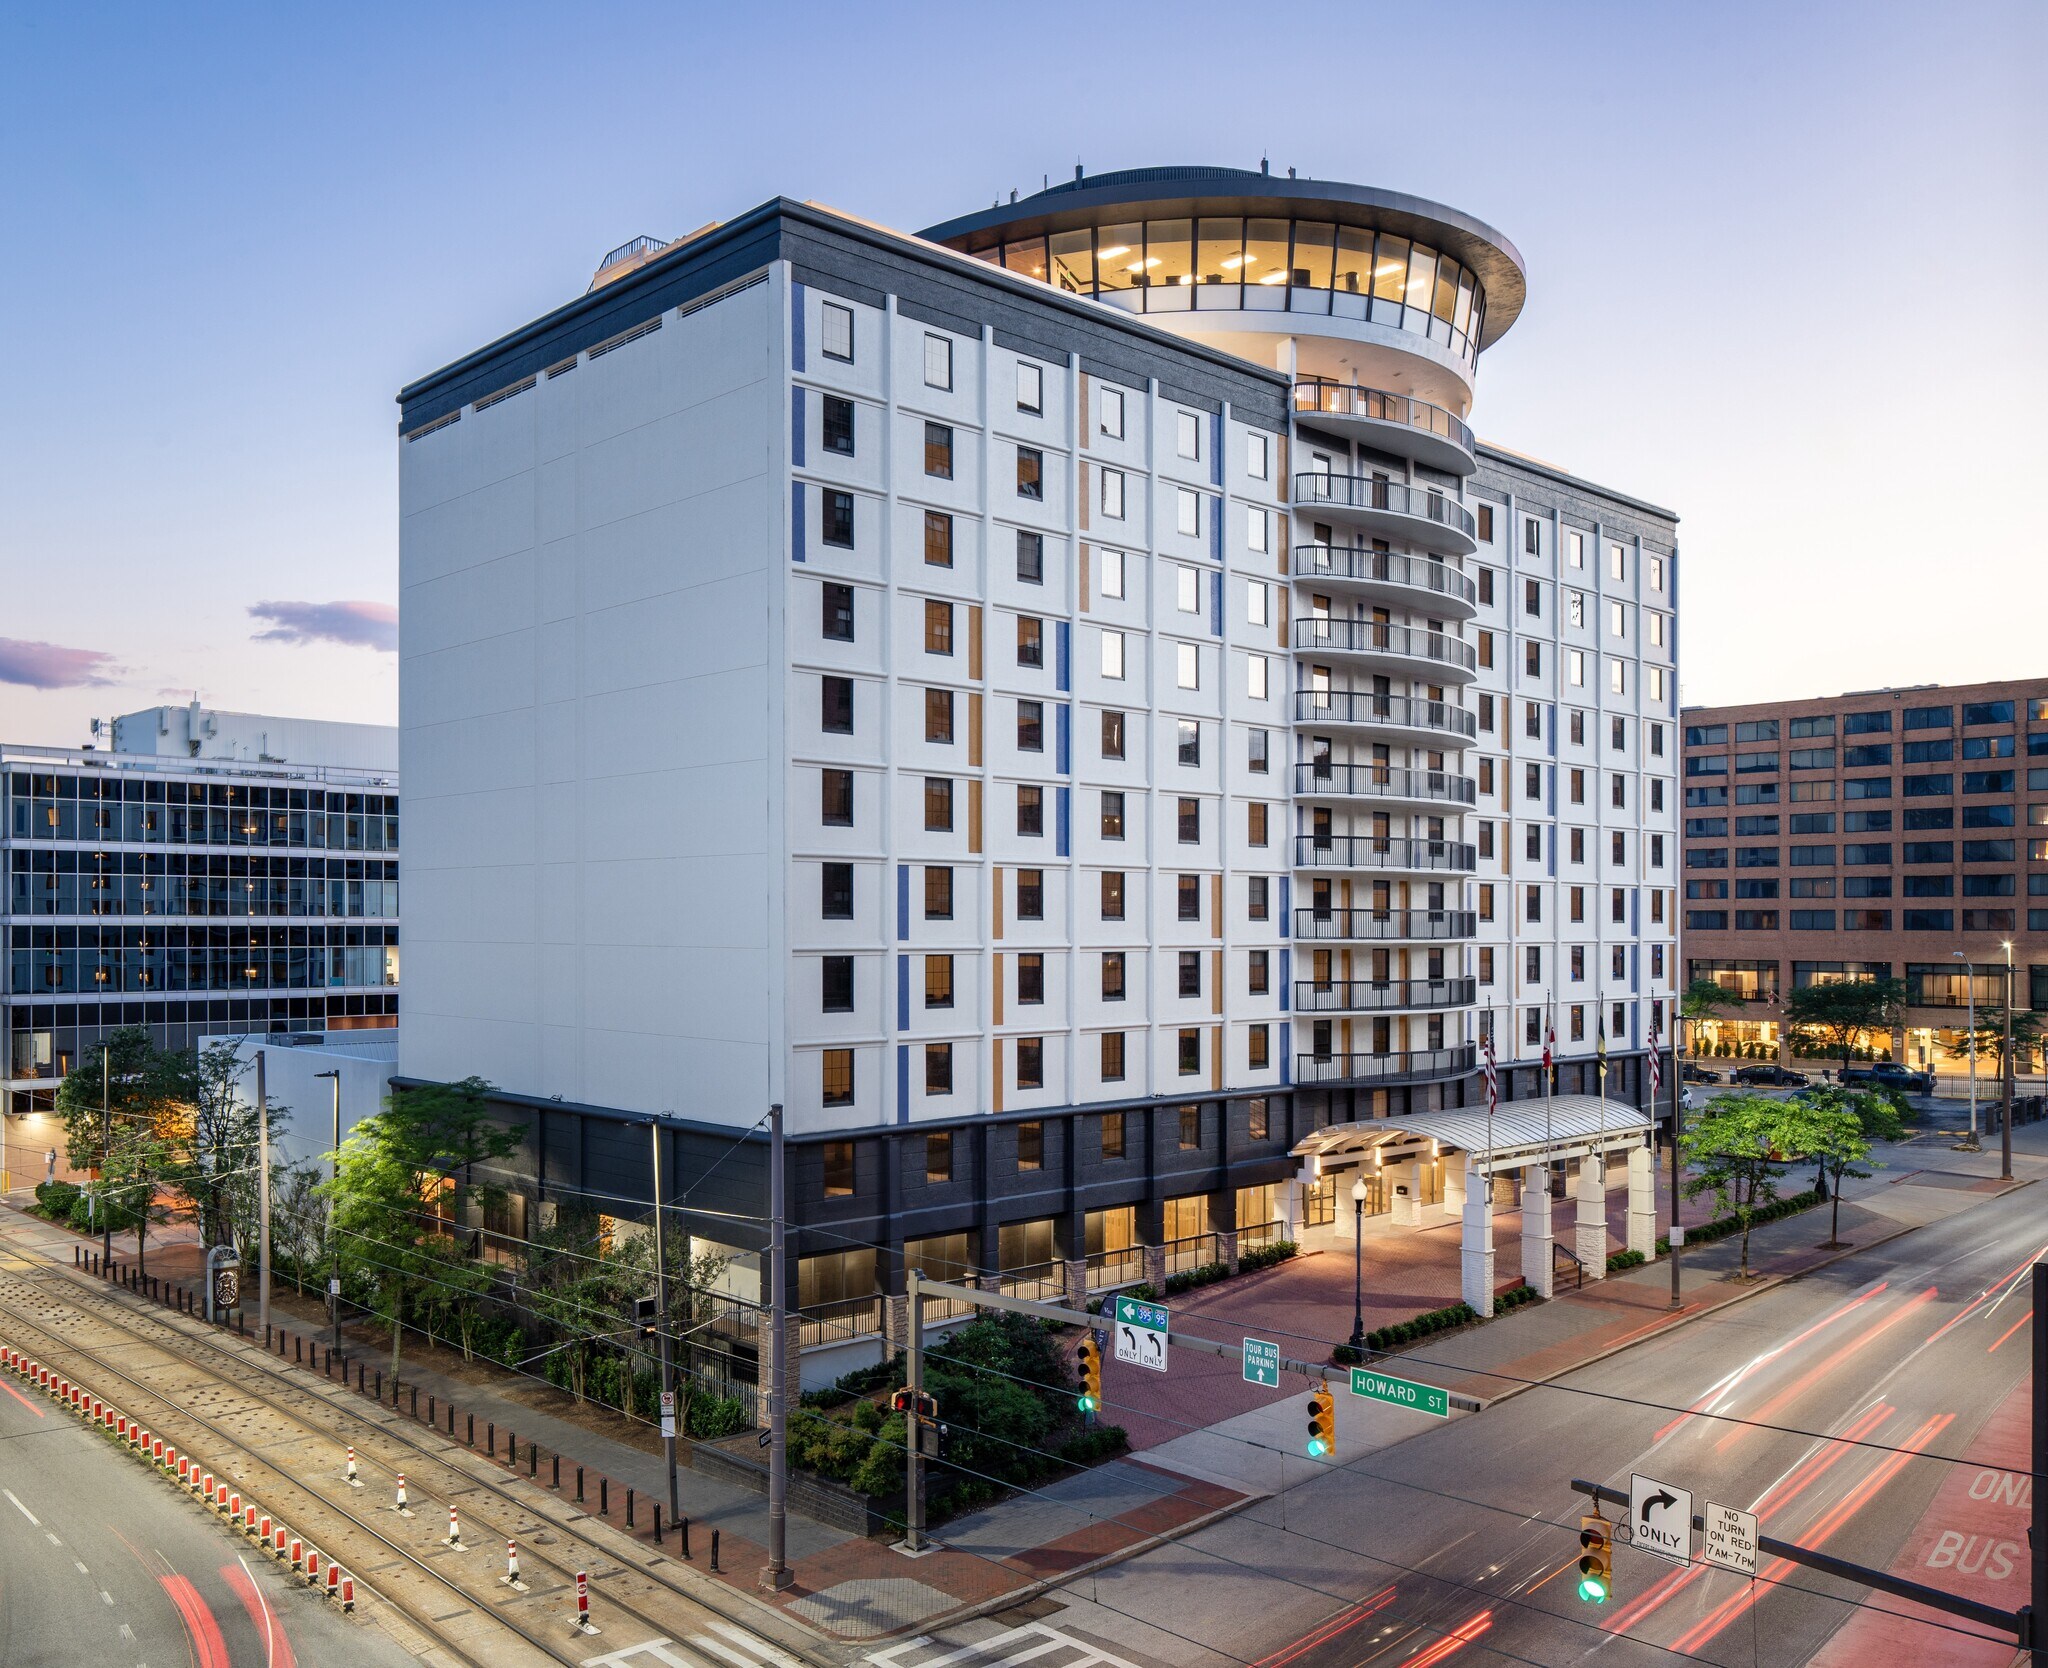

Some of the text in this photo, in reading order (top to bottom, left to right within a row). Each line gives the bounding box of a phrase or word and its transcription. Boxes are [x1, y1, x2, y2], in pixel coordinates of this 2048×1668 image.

[1138, 1309, 1166, 1325] 395 95
[1119, 1348, 1138, 1360] ONLY
[1245, 1342, 1277, 1359] TOUR BUS
[1143, 1355, 1163, 1367] ONLY
[1247, 1354, 1275, 1370] PARKING
[1356, 1375, 1444, 1410] HOWARD ST.
[1968, 1470, 2032, 1509] ONL
[1724, 1510, 1739, 1522] NO
[1639, 1524, 1681, 1548] ONLY
[1718, 1520, 1745, 1537] TURN
[1710, 1530, 1752, 1551] ON RED
[1925, 1530, 2020, 1580] BUS
